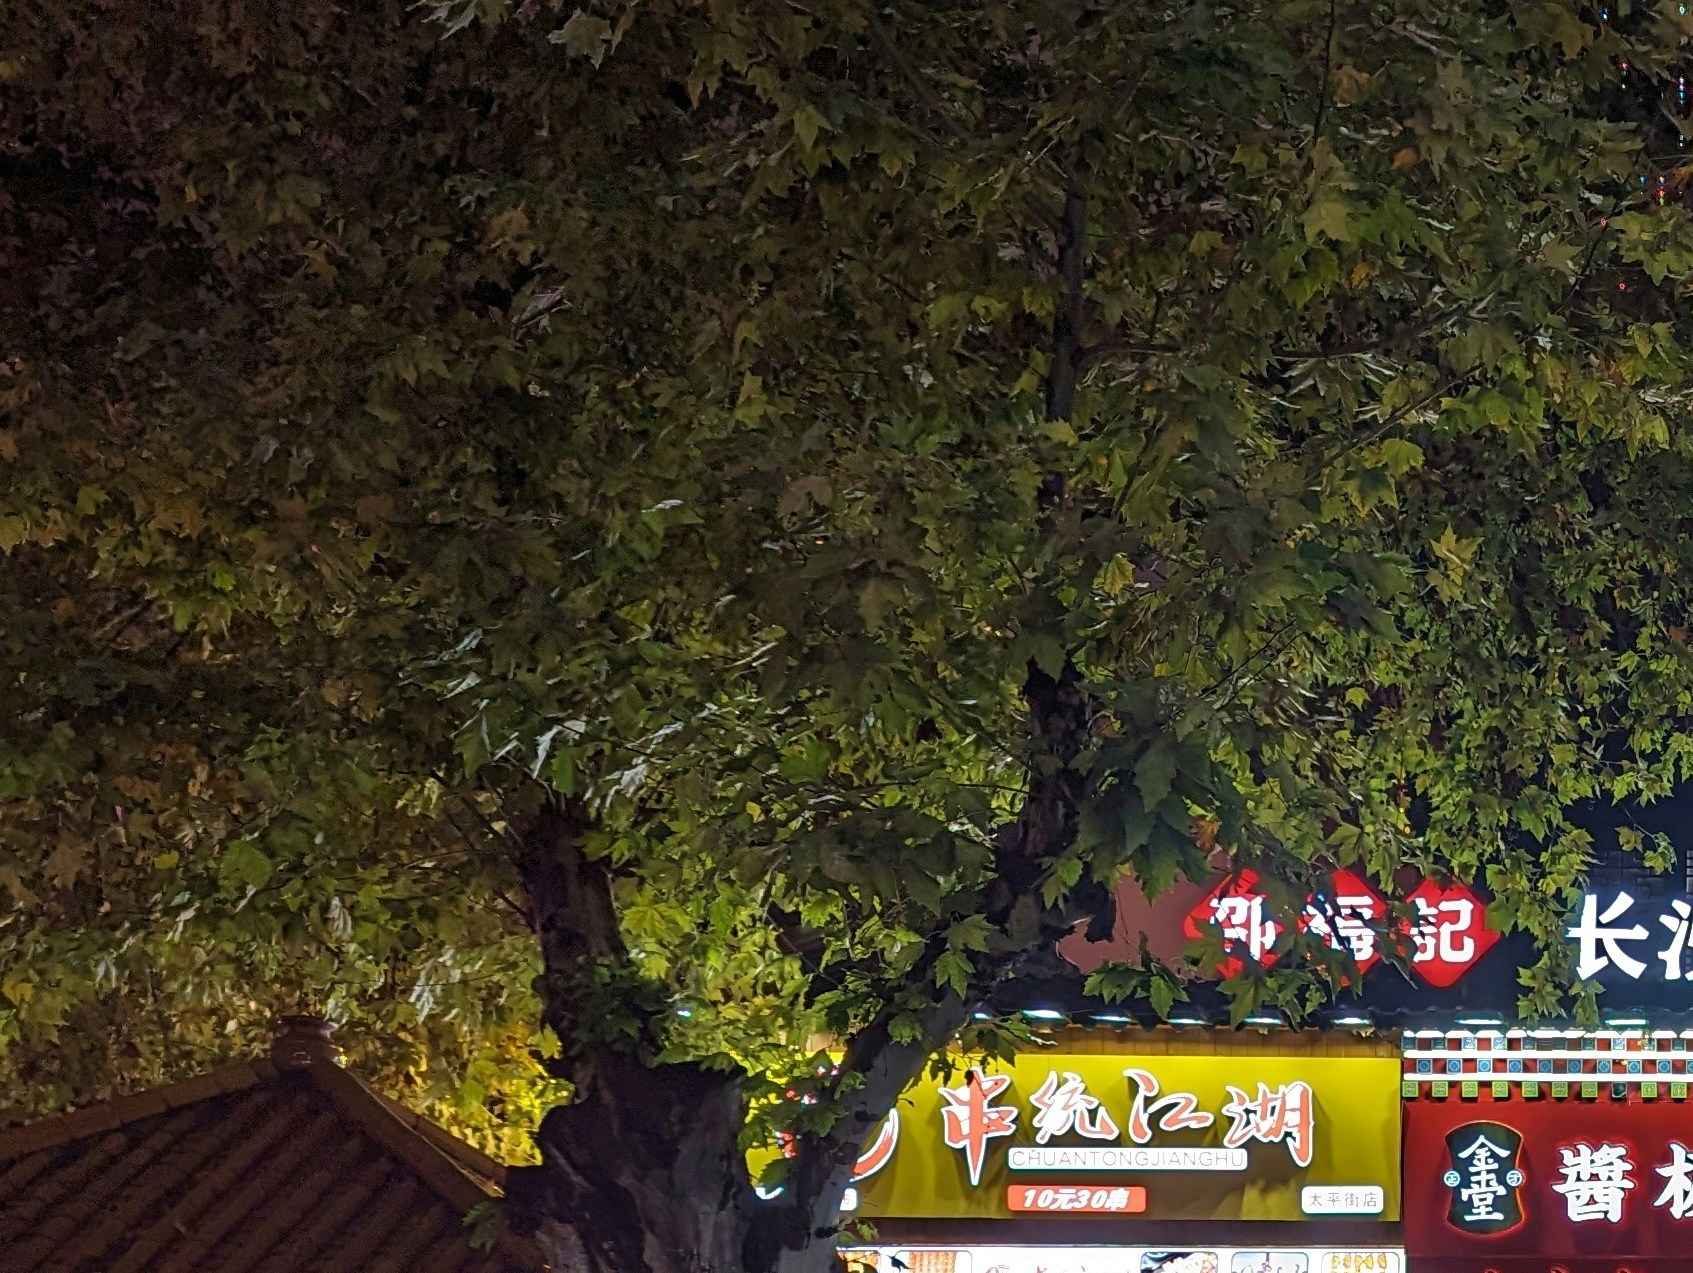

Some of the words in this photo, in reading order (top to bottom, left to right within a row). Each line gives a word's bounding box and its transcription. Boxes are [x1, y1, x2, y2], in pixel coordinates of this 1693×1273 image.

[937, 1066, 1314, 1186] 串统江湖
[1011, 1150, 1245, 1168] CHUANTONGJIANGHU
[1023, 1188, 1131, 1211] 10元30串
[1308, 1191, 1378, 1208] 太平街店
